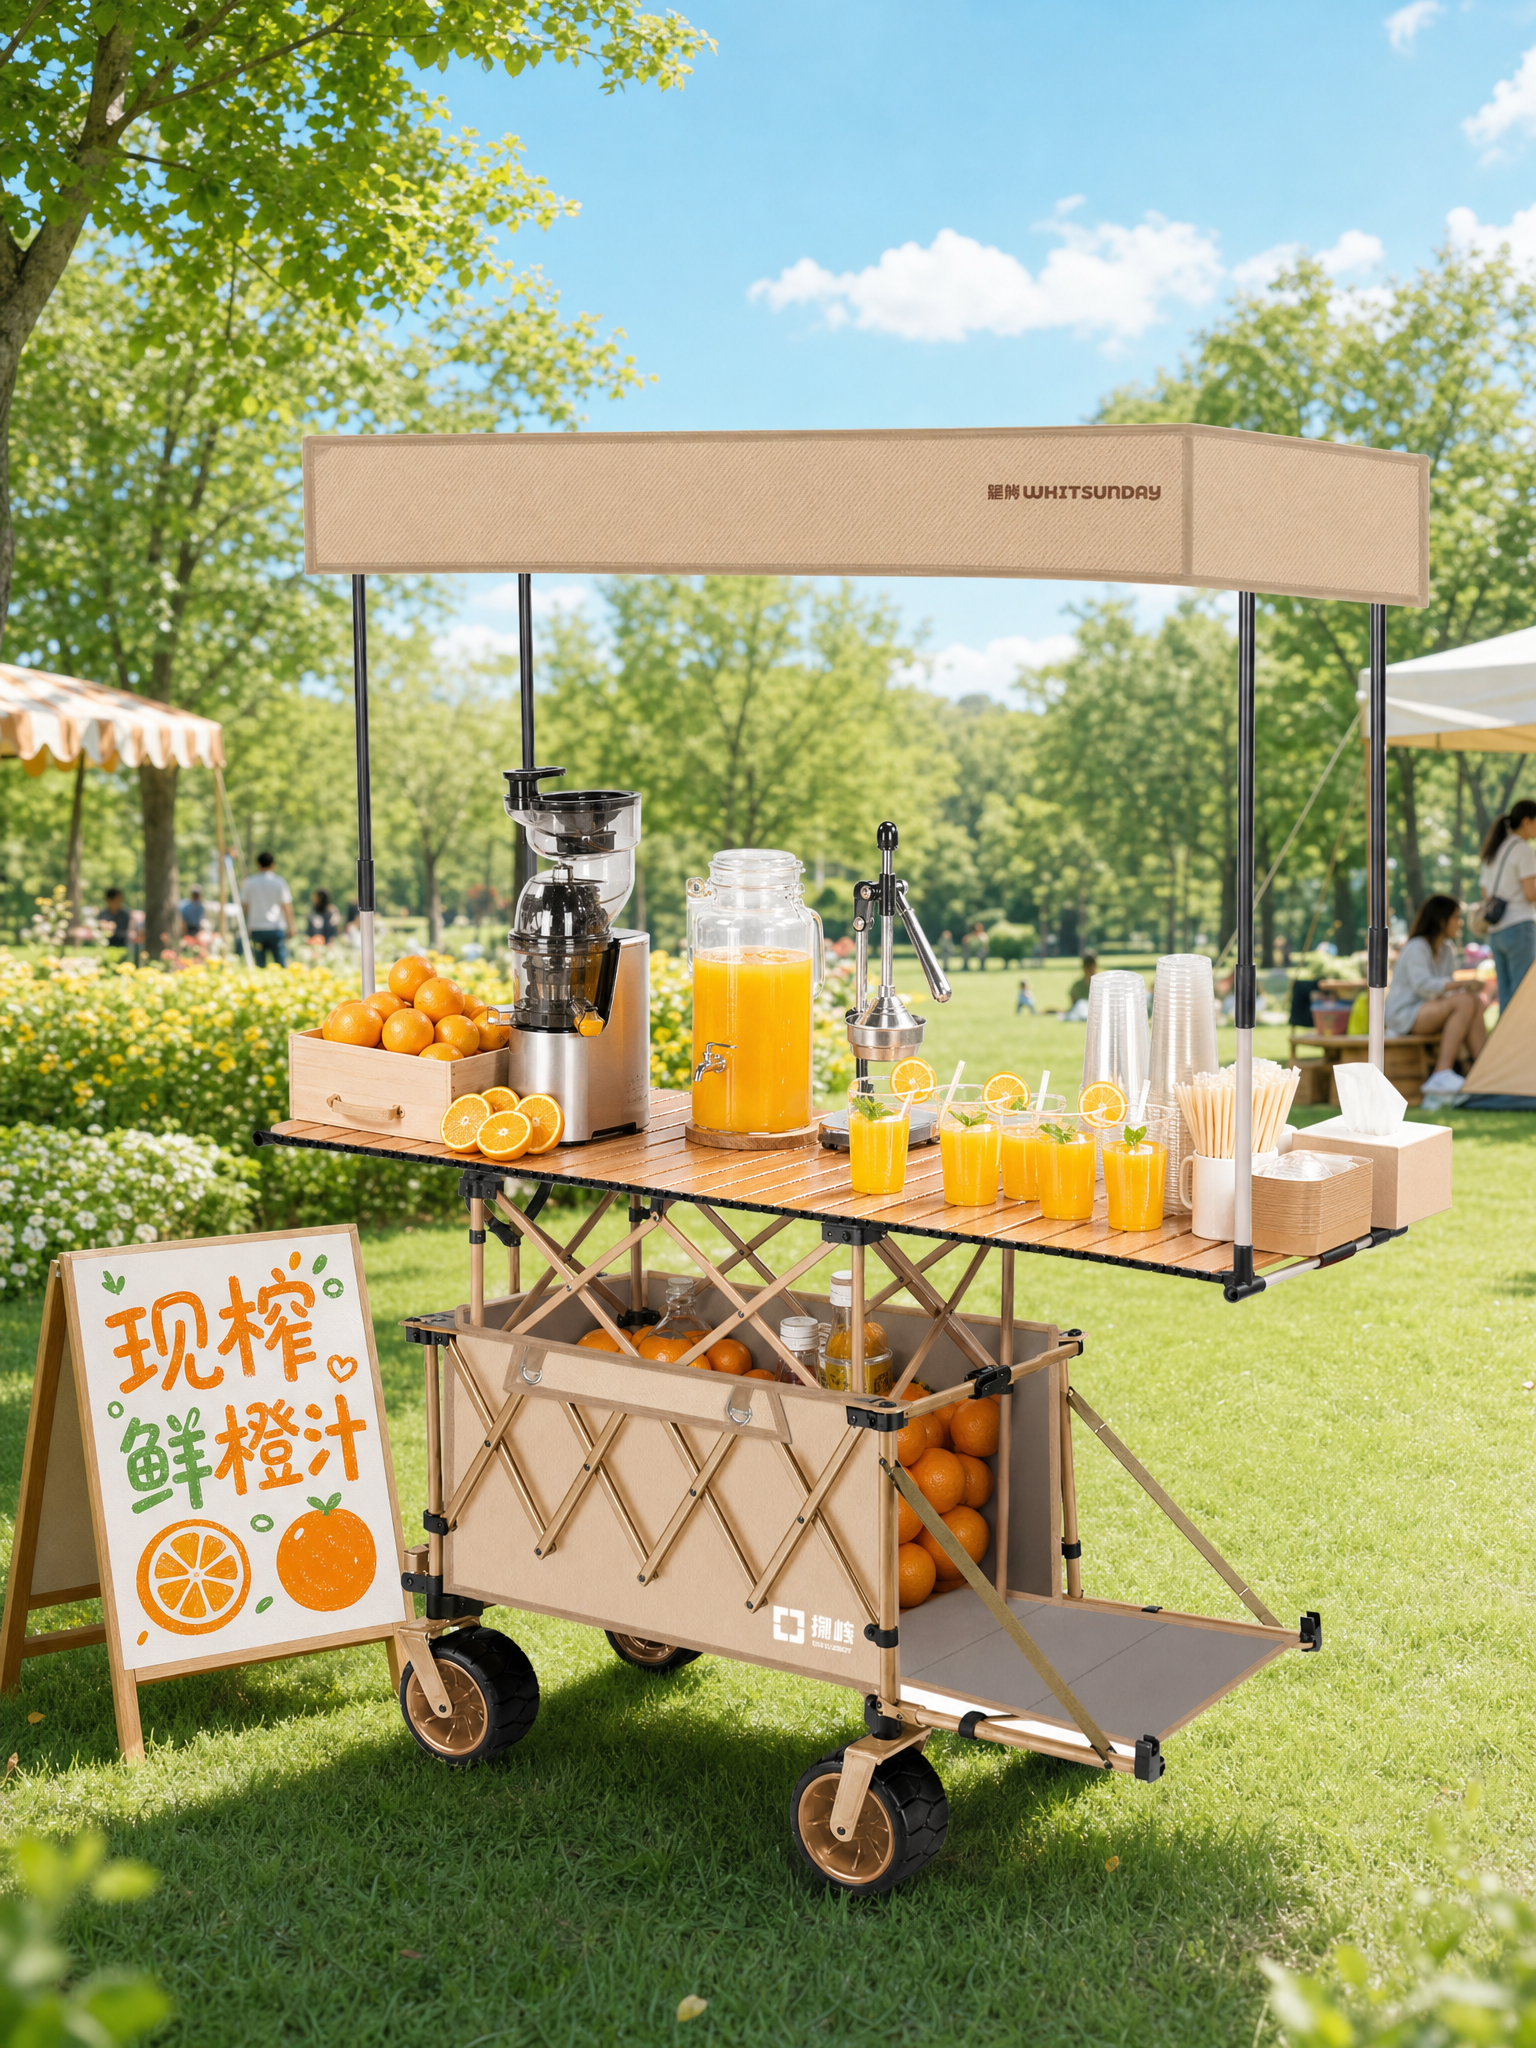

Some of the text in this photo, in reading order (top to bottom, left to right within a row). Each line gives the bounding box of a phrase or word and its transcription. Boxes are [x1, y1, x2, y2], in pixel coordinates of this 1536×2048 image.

[1023, 485, 1161, 501] WHITSUNDAY
[105, 1275, 316, 1394] 现榨
[120, 1394, 367, 1514] 鲜橙汁
